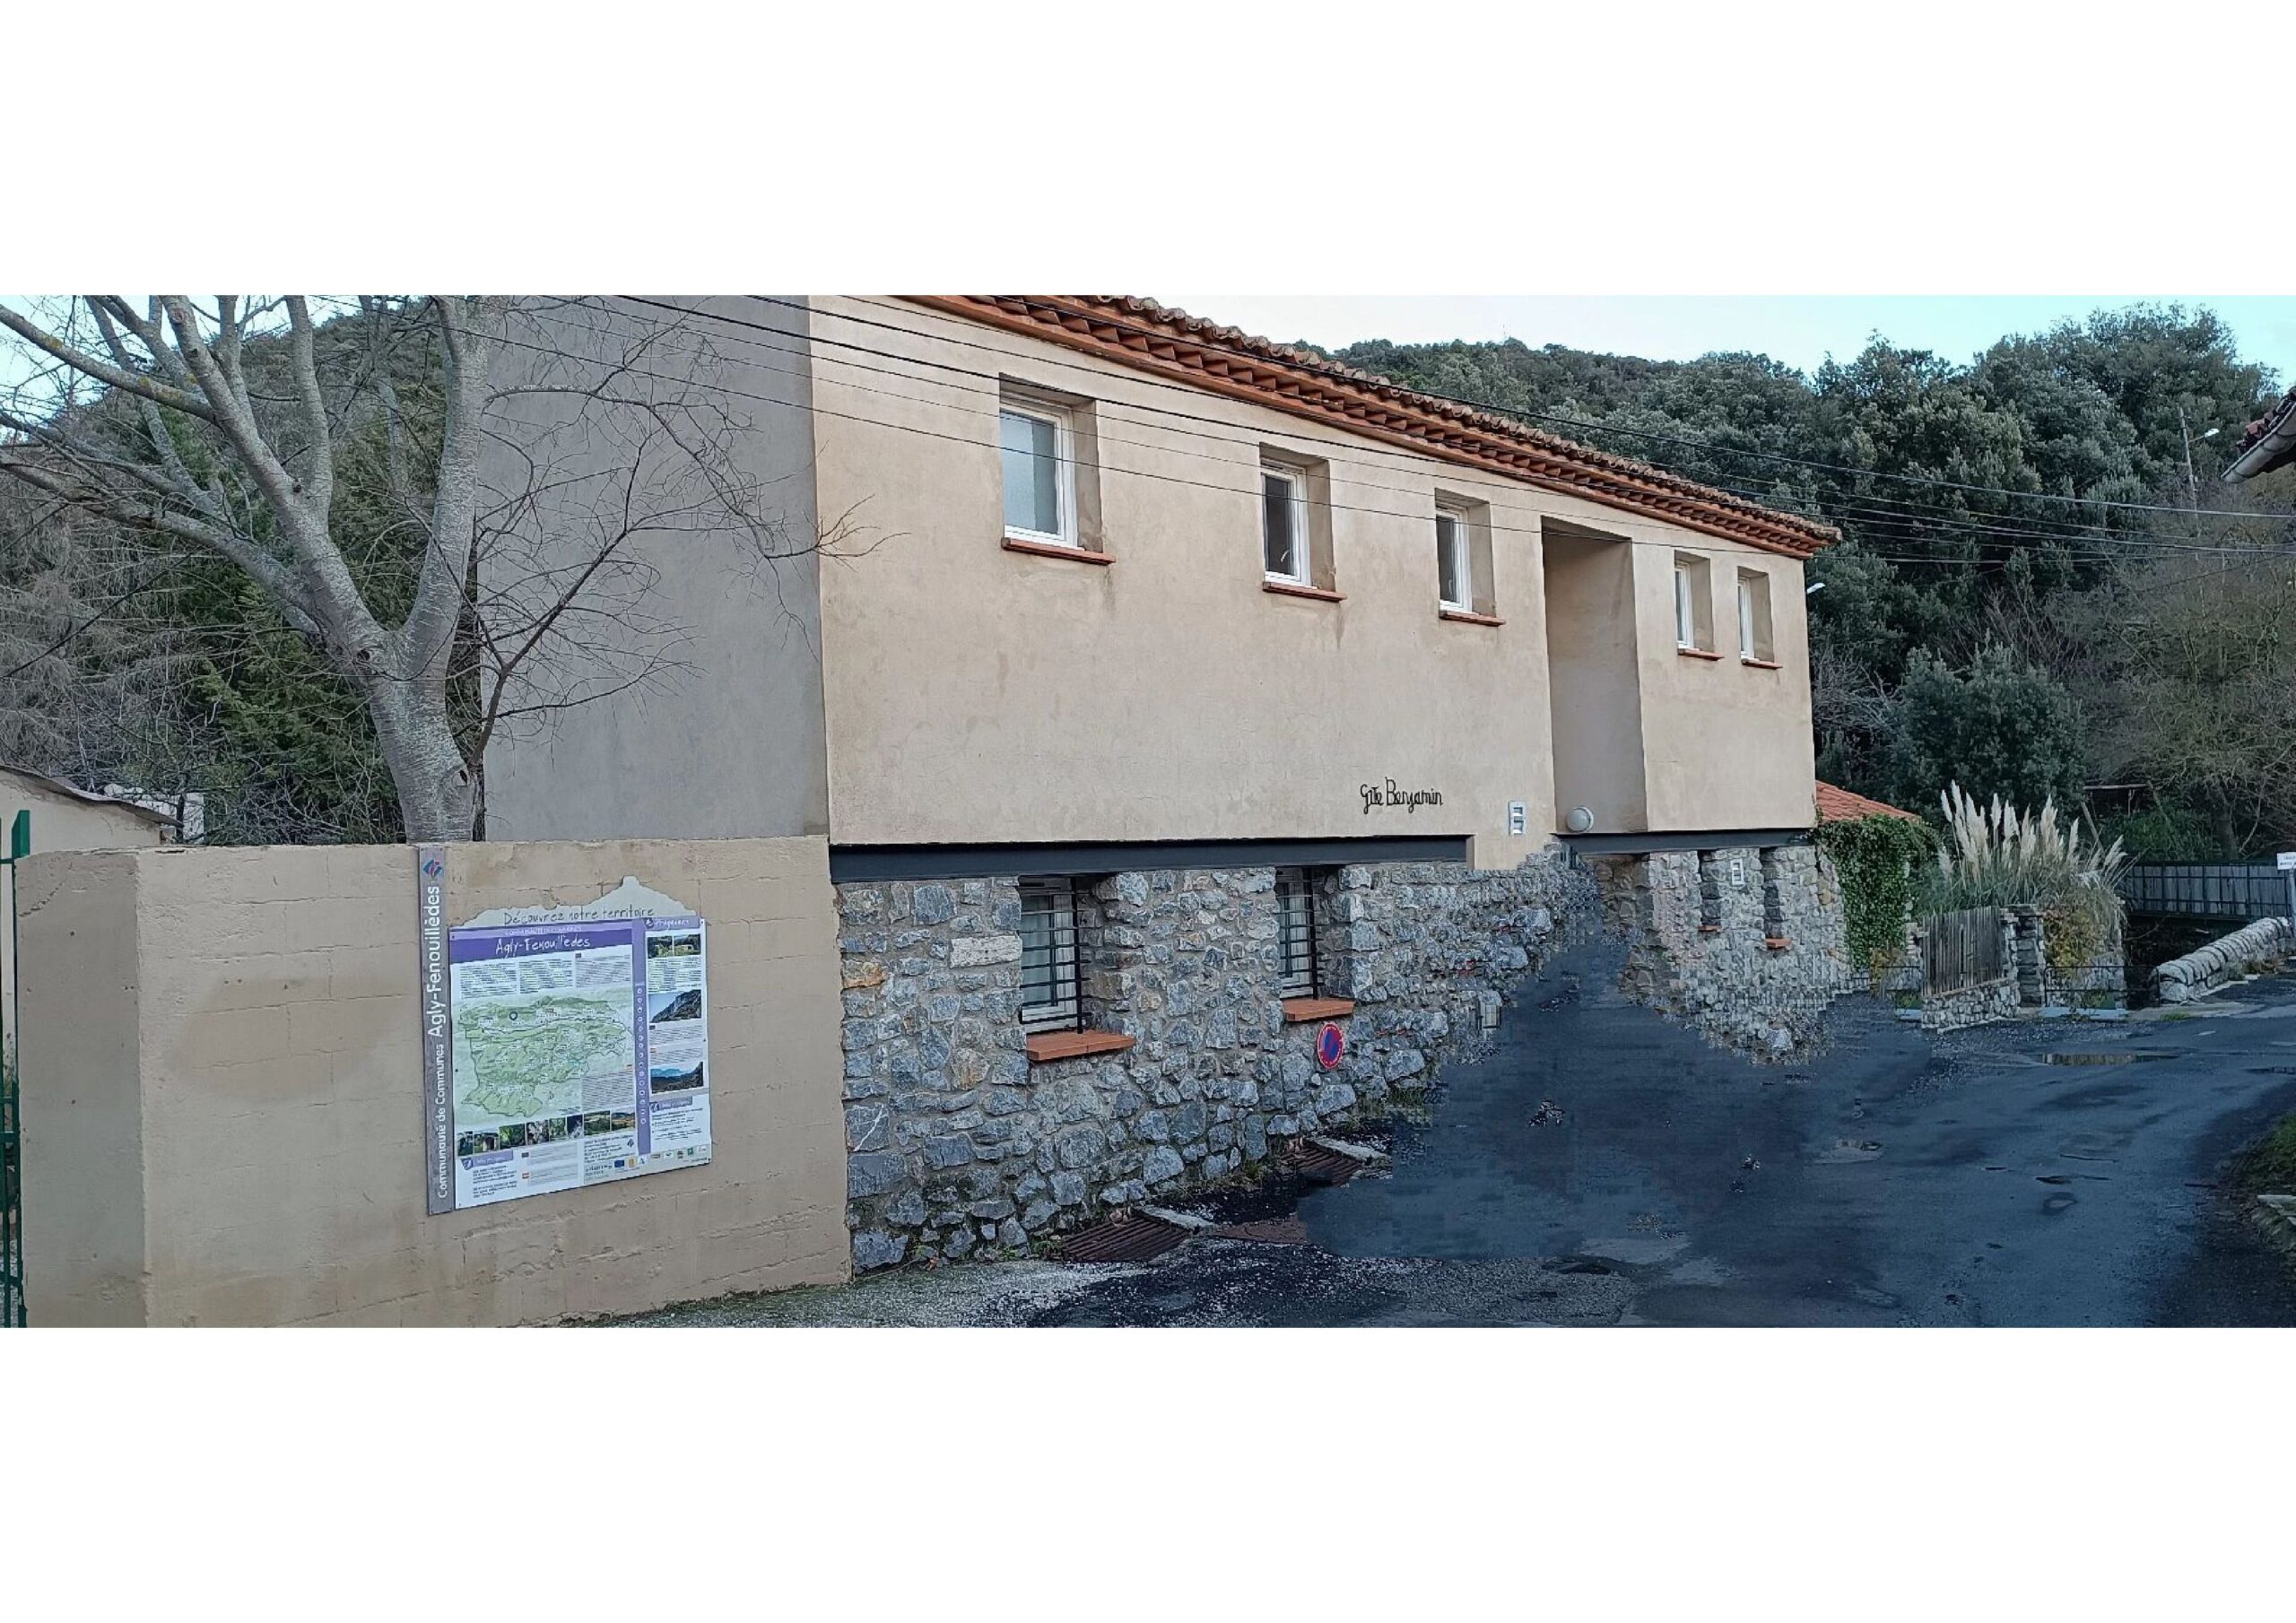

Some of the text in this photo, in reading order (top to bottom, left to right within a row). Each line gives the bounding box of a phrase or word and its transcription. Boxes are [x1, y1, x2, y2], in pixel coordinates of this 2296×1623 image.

[504, 905, 654, 925] Découvrez notre territoire
[435, 1045, 446, 1105] Communes
[436, 1107, 446, 1122] de
